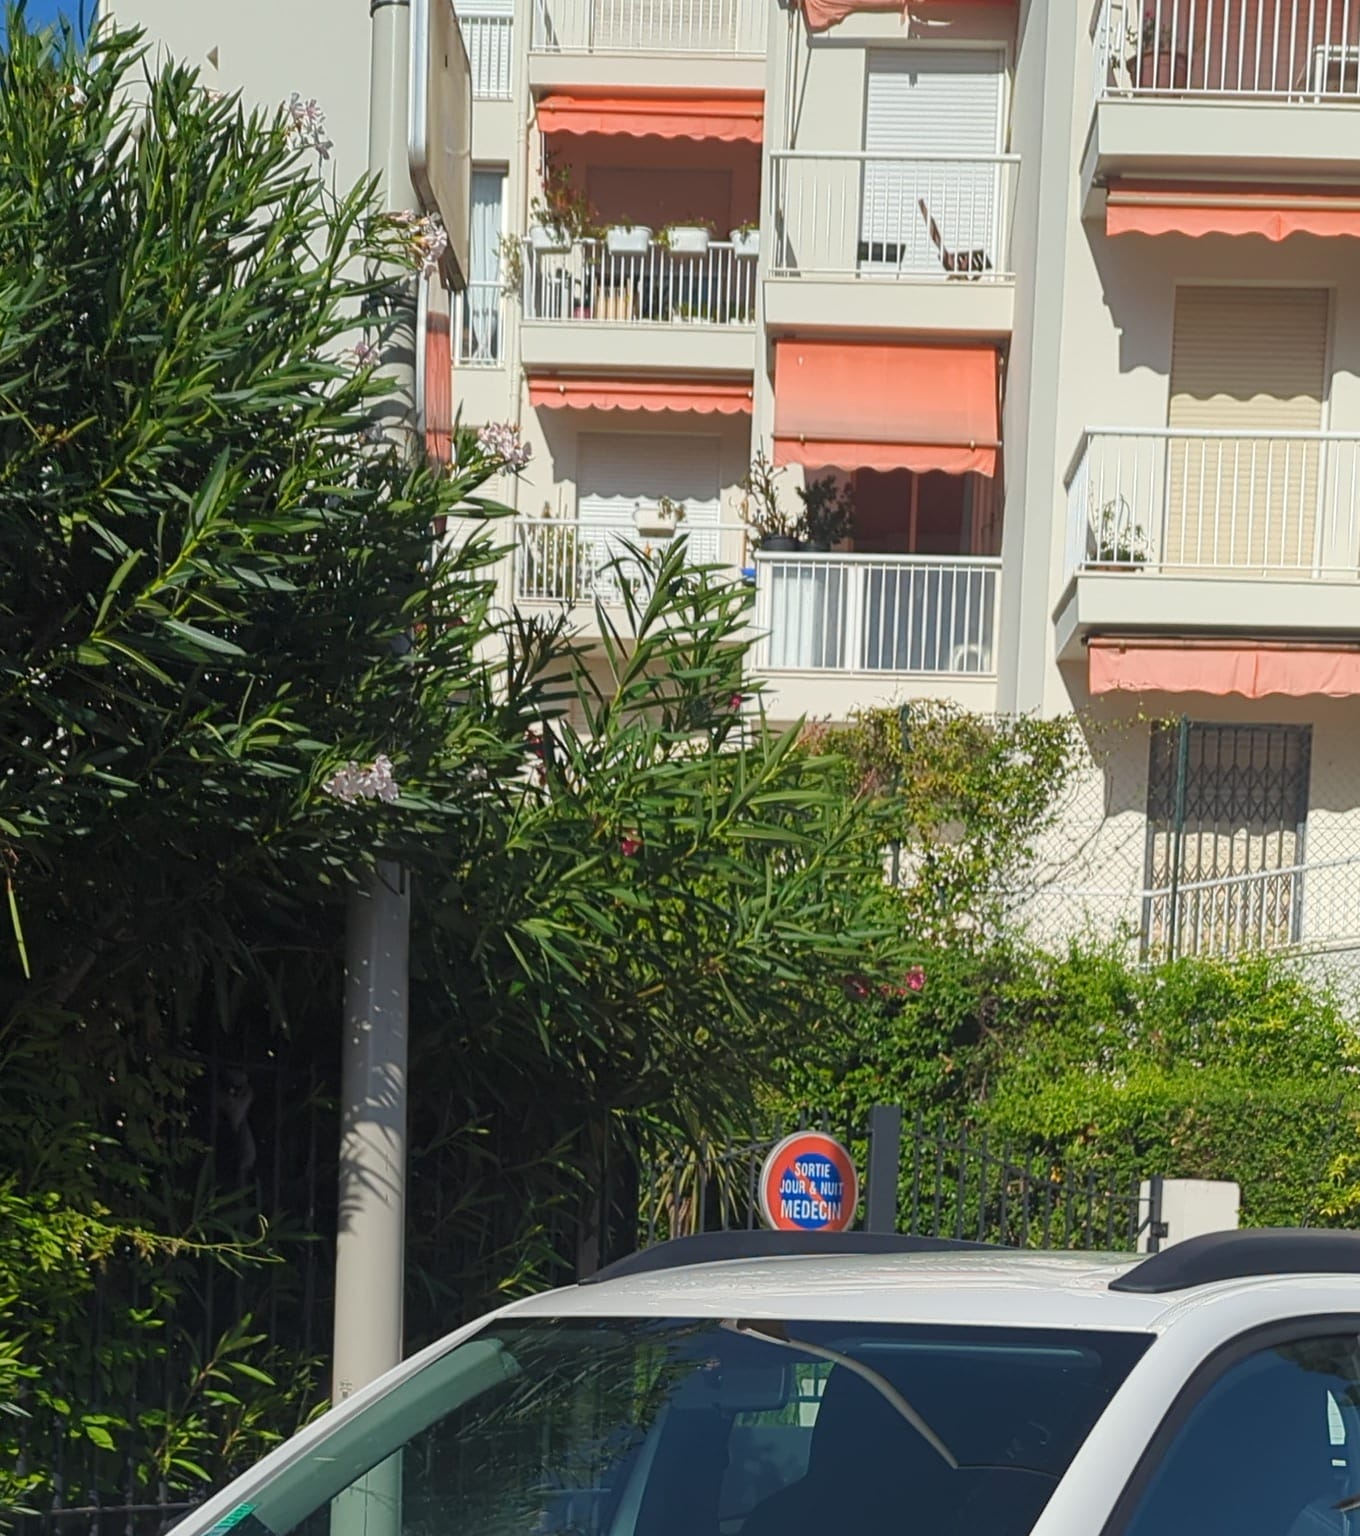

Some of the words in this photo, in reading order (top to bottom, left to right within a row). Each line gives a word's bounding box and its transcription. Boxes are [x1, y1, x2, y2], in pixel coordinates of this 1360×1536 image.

[794, 1162, 831, 1178] SORTIE
[779, 1179, 806, 1194] JOUR
[809, 1180, 817, 1195] &
[820, 1181, 844, 1196] NUIT
[780, 1199, 842, 1221] MEDECIN
